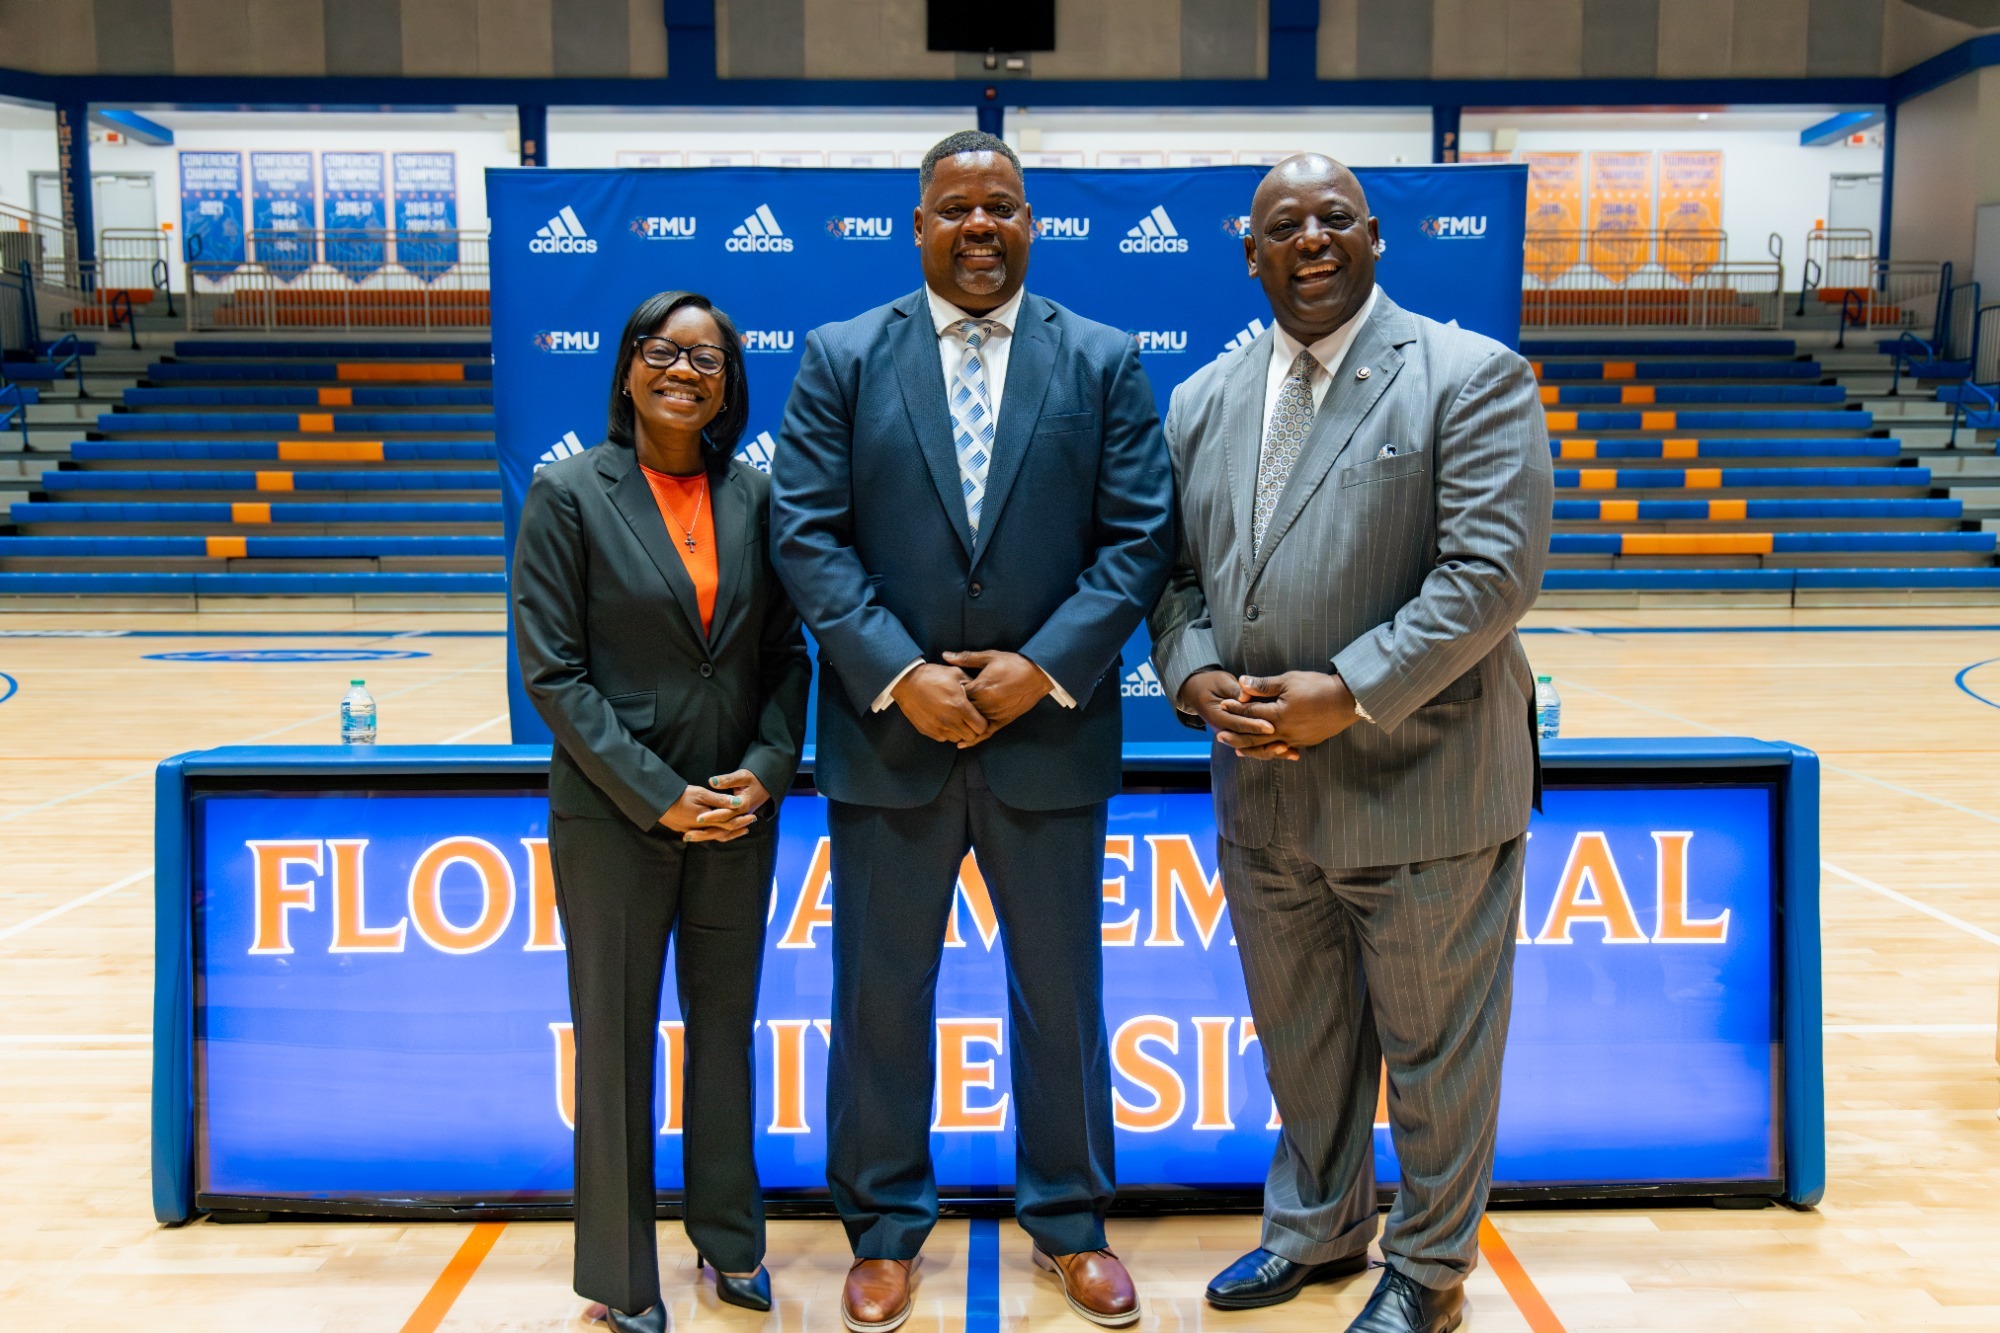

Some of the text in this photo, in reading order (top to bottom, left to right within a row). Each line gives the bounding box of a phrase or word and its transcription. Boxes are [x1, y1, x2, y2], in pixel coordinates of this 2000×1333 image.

[647, 217, 696, 236] FMU
[843, 217, 893, 236] FMU
[1041, 217, 1090, 236] FMU
[1437, 216, 1487, 235] FMU
[529, 236, 598, 253] adidas
[725, 235, 794, 253] adidas
[1119, 236, 1189, 254] adidas
[550, 331, 600, 350] FMU
[745, 331, 794, 349] FMU
[1138, 331, 1187, 349] FMU
[1121, 681, 1166, 697] adid
